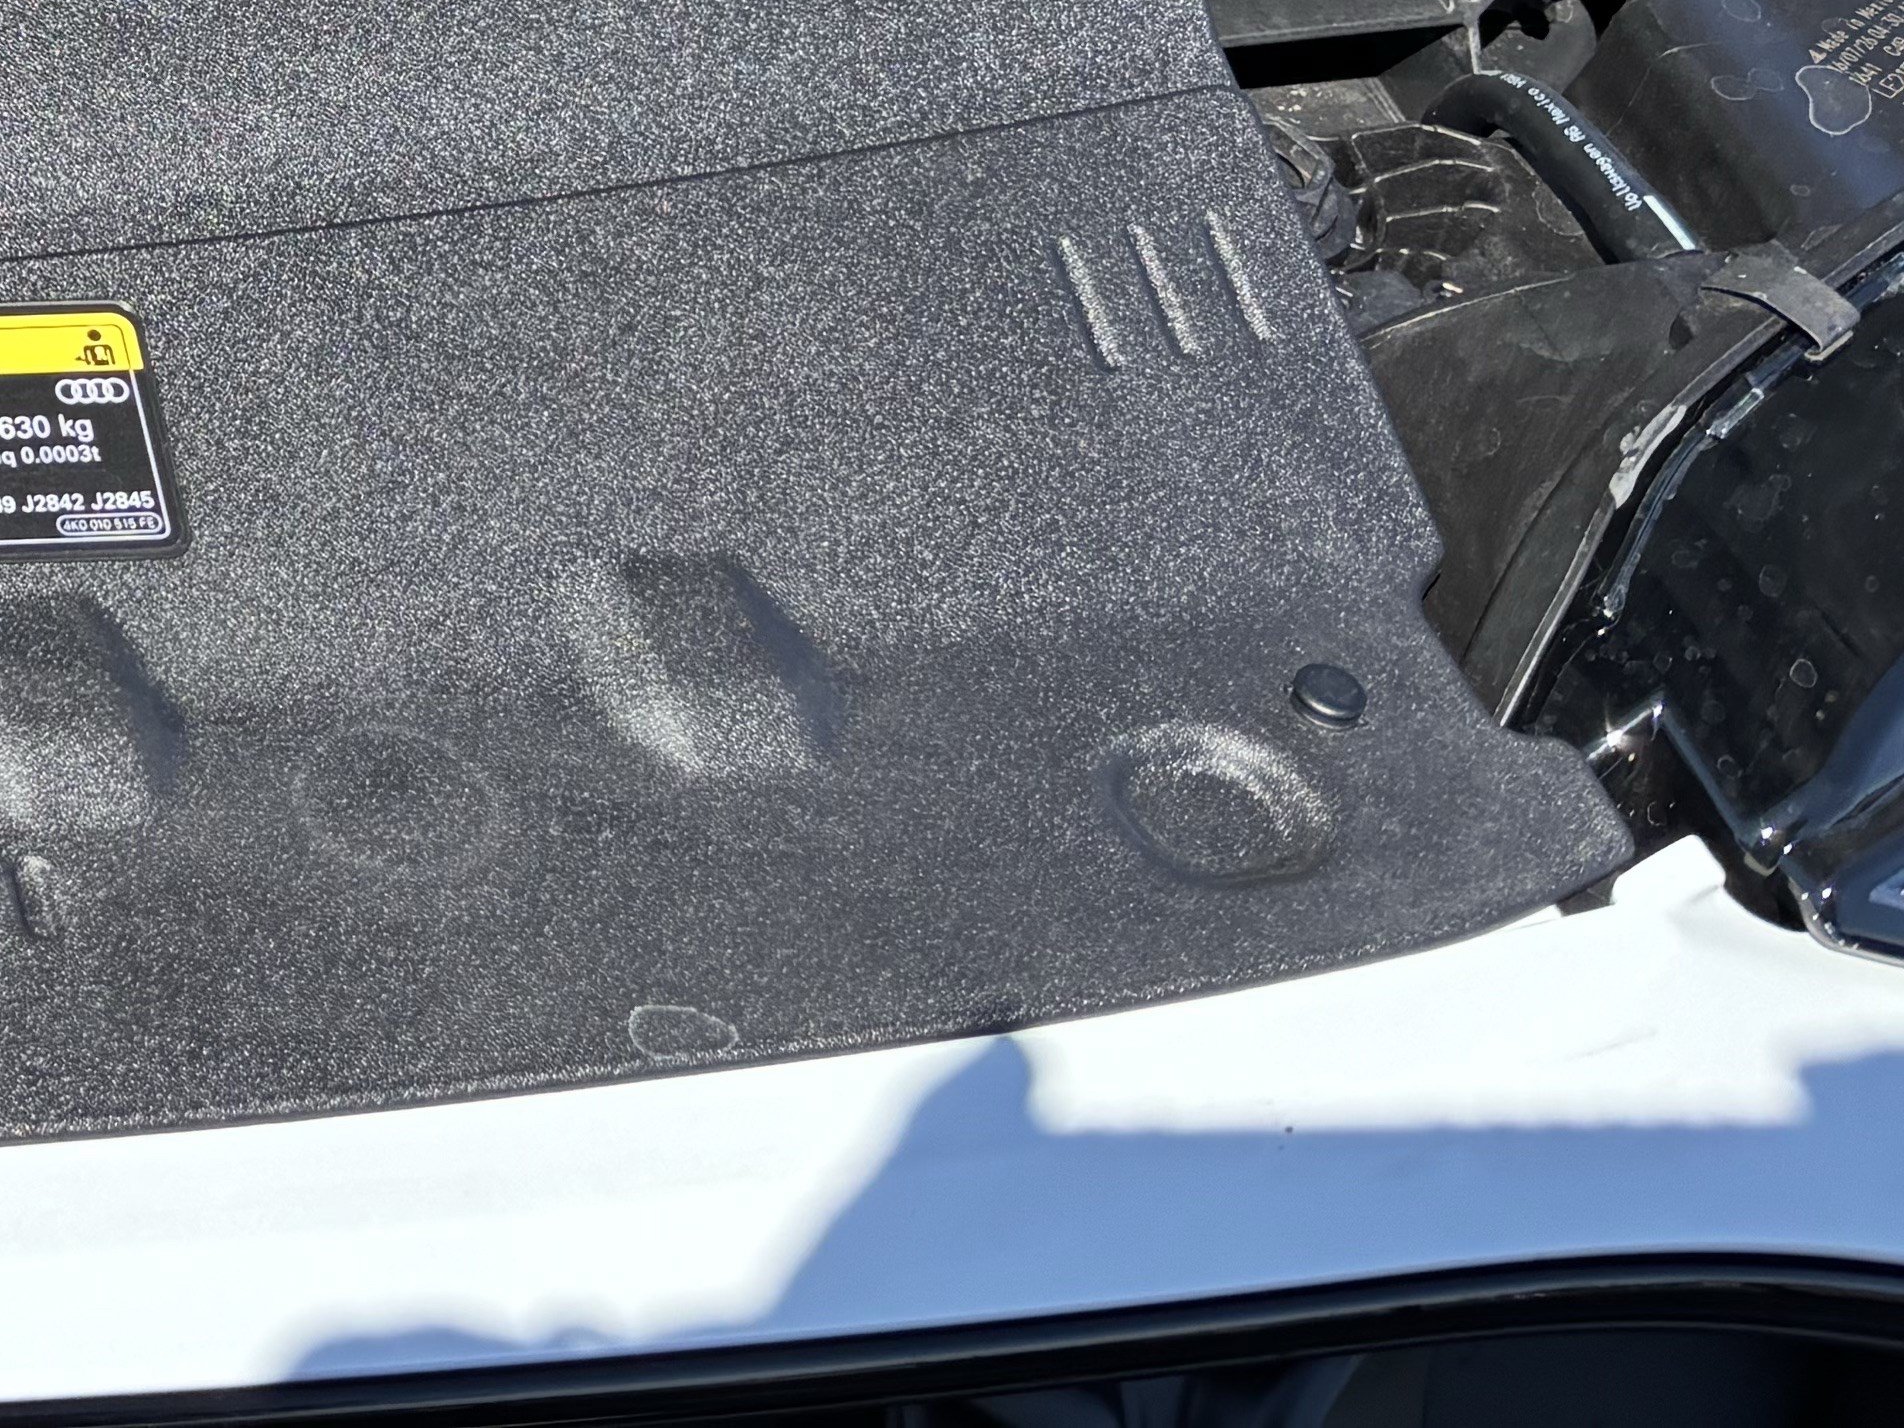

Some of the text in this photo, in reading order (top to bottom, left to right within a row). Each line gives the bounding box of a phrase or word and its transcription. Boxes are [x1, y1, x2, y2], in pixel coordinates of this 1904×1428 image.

[1527, 88, 1570, 126] Mexico
[1563, 125, 1586, 143] AG
[1583, 143, 1642, 211] Volkswagen
[57, 413, 95, 443] kg
[20, 444, 102, 464] 0.0003t
[21, 493, 85, 513] J2842
[91, 490, 155, 511] J2845
[89, 518, 112, 530] 010
